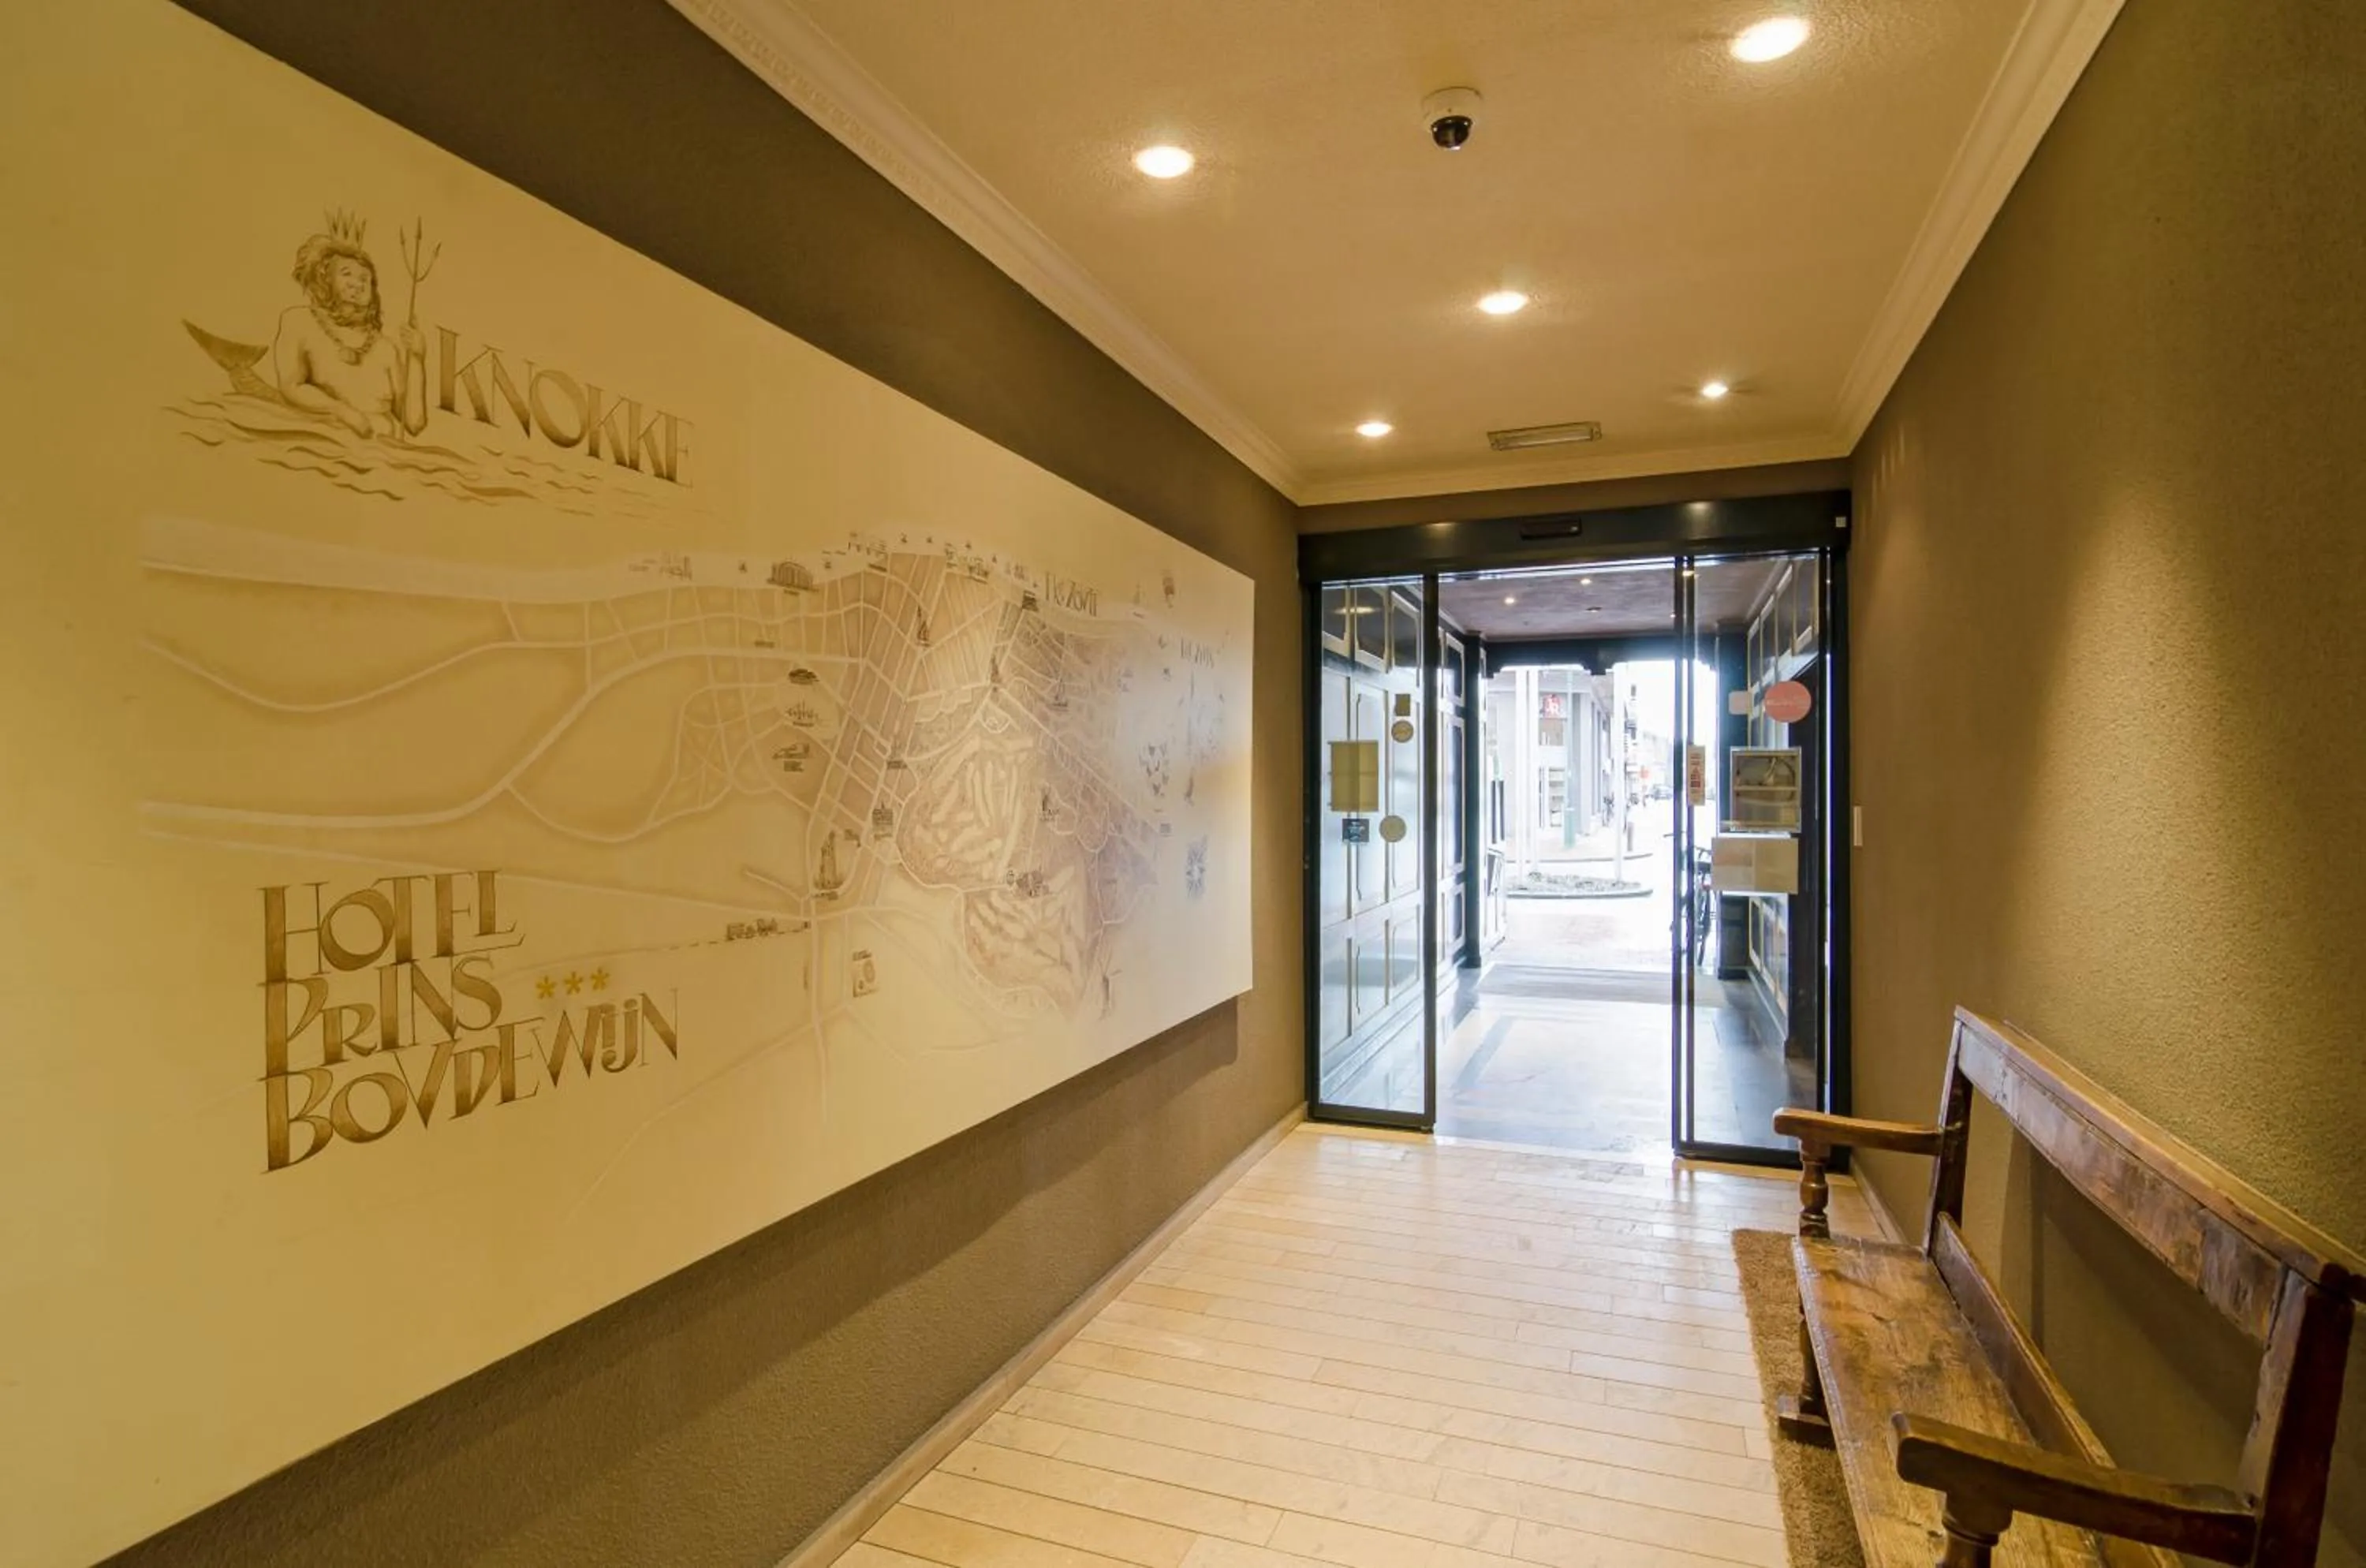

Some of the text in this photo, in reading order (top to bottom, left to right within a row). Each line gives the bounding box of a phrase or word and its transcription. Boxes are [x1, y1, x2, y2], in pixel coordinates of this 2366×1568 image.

[436, 325, 695, 491] KNOKKE
[257, 868, 526, 984] HOTEL
[257, 954, 503, 1078] PRINS
